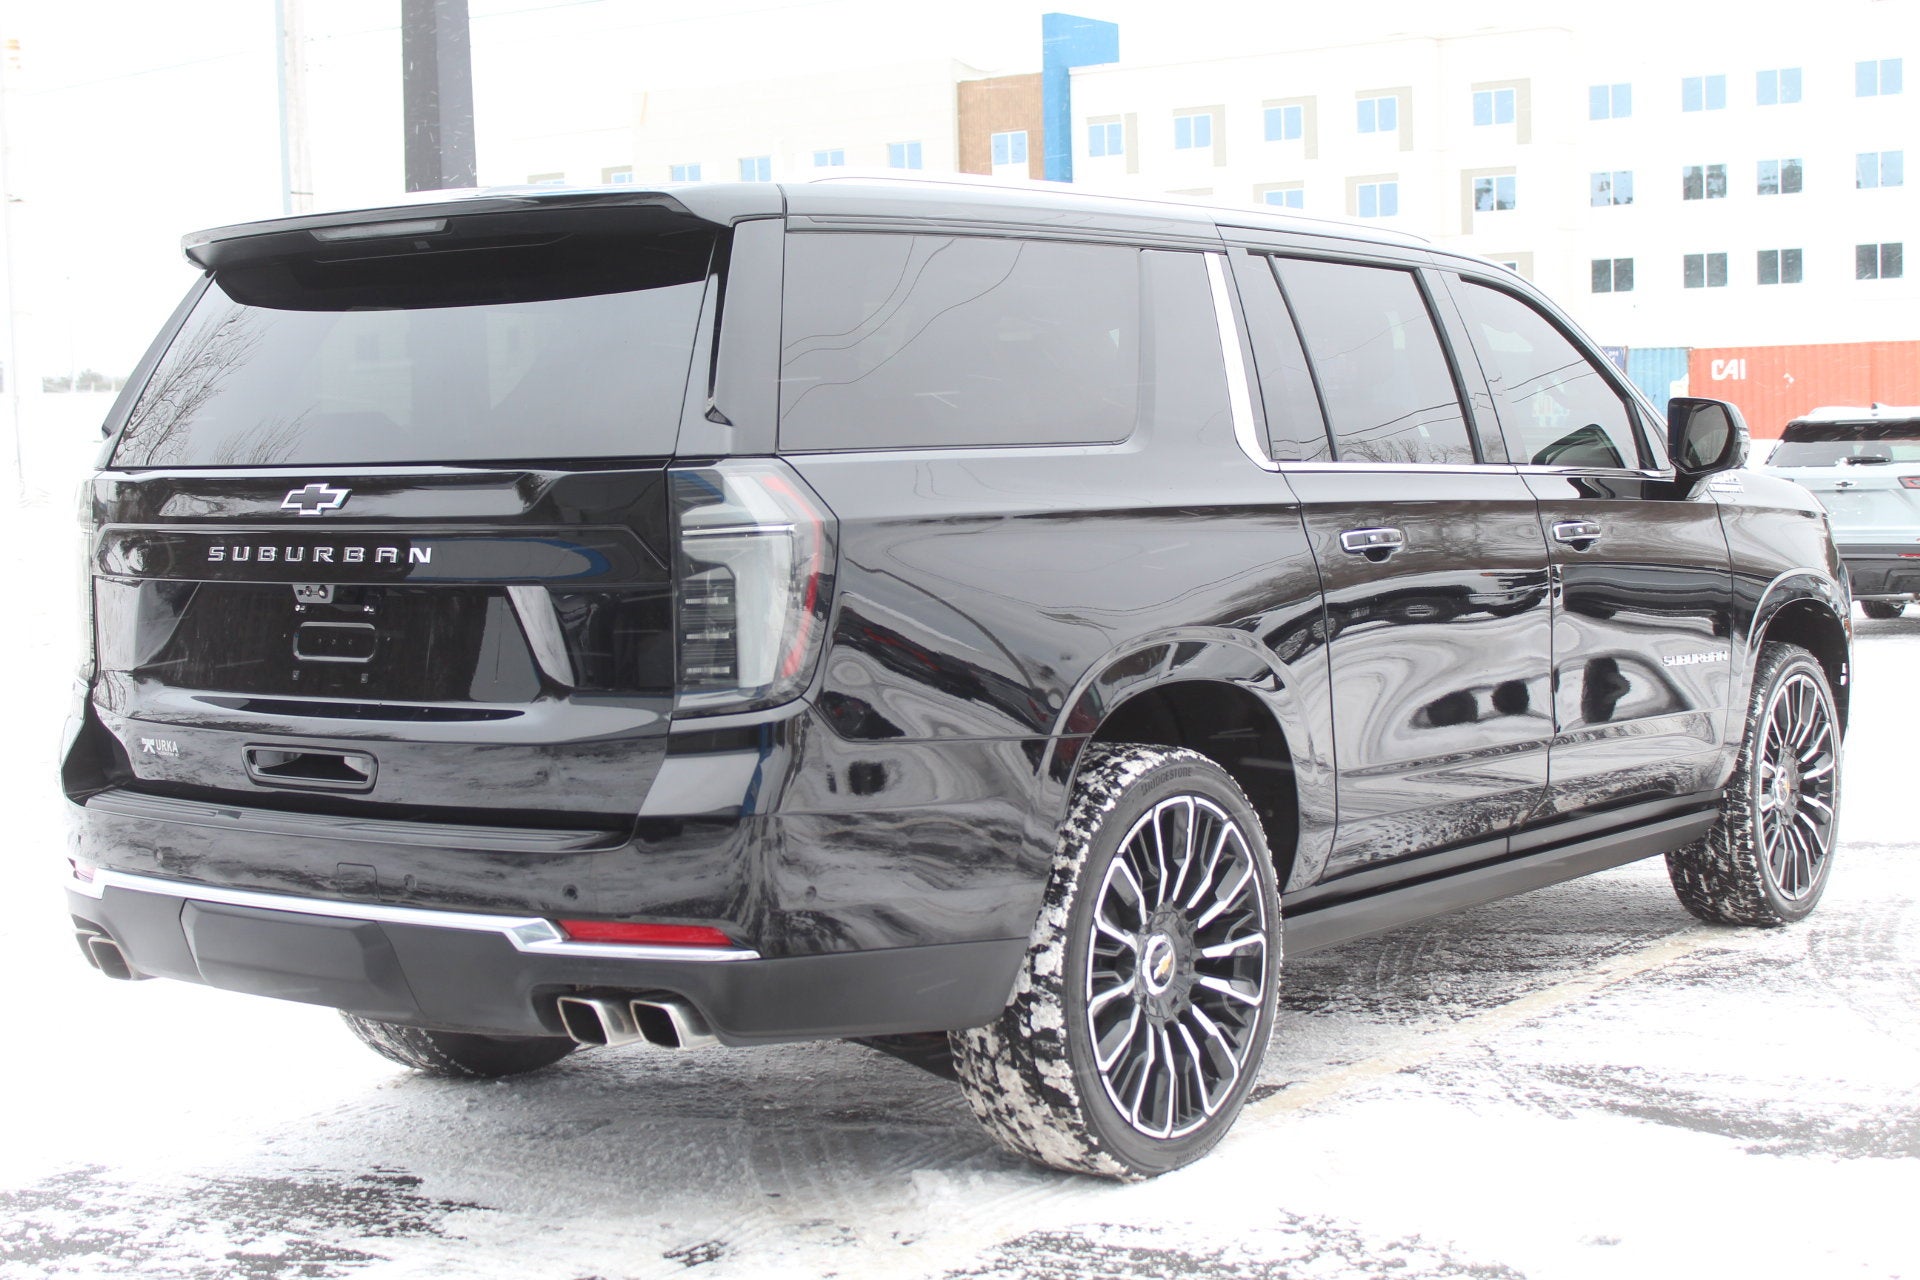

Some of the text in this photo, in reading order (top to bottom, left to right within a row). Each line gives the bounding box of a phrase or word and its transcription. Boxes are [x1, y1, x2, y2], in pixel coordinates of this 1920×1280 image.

[1711, 358, 1746, 381] CAI
[207, 546, 432, 564] SUBURBAN
[1662, 650, 1728, 667] SUBURBAN
